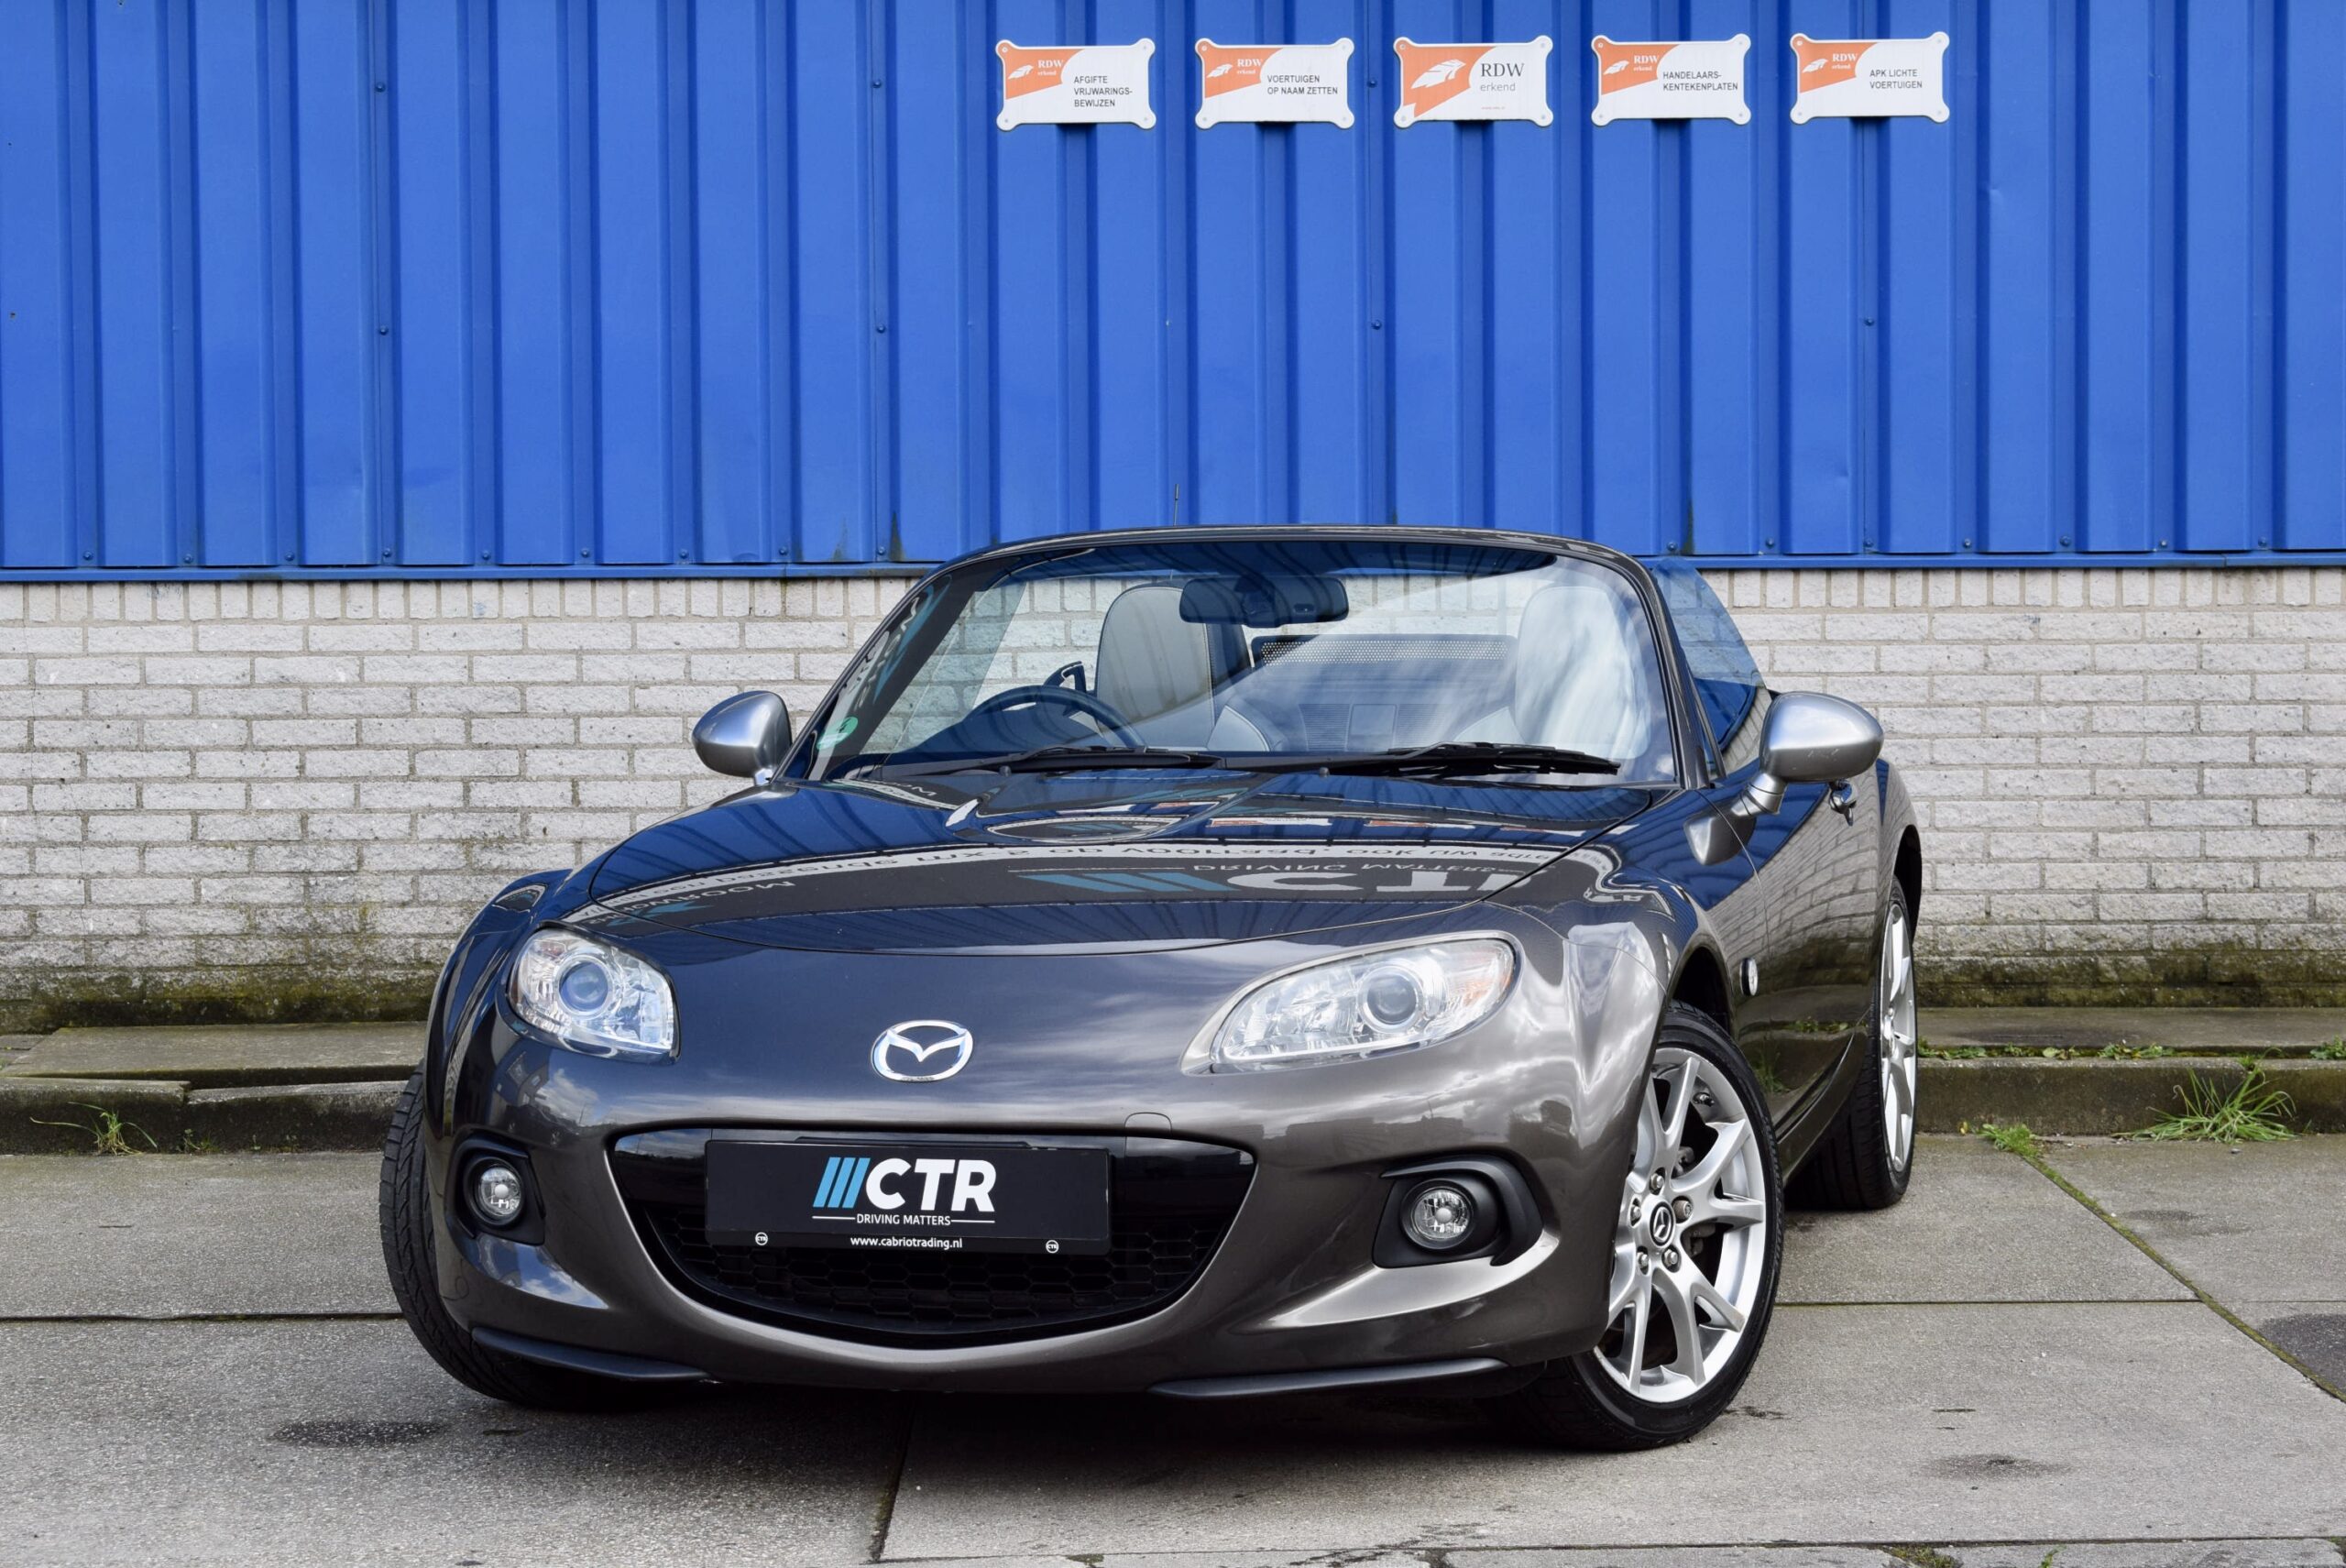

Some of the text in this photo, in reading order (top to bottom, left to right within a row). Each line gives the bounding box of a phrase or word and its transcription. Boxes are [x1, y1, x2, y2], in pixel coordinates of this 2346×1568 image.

[1634, 55, 1660, 64] RDW
[1833, 53, 1858, 61] RDW
[1037, 60, 1064, 68] RDW
[1238, 59, 1262, 67] RDW
[1481, 62, 1525, 77] RDW
[1869, 69, 1918, 77] APK LICHTE
[1267, 75, 1320, 83] VOERTUIGEN
[1663, 71, 1722, 80] HANDELAARS-
[1074, 76, 1108, 84] AFGIFTE
[1480, 82, 1516, 92] erkend
[1663, 82, 1738, 91] KENTEKENPLATEN
[1869, 81, 1923, 89] VOERTUIGEN
[1074, 87, 1133, 95] VRIJWARINGS-
[1074, 99, 1115, 107] BEWIJZEN
[866, 1157, 997, 1212] CTR
[856, 1213, 951, 1226] DRIVING MATTERS
[850, 1236, 962, 1250] www.cabriotrading.nl
